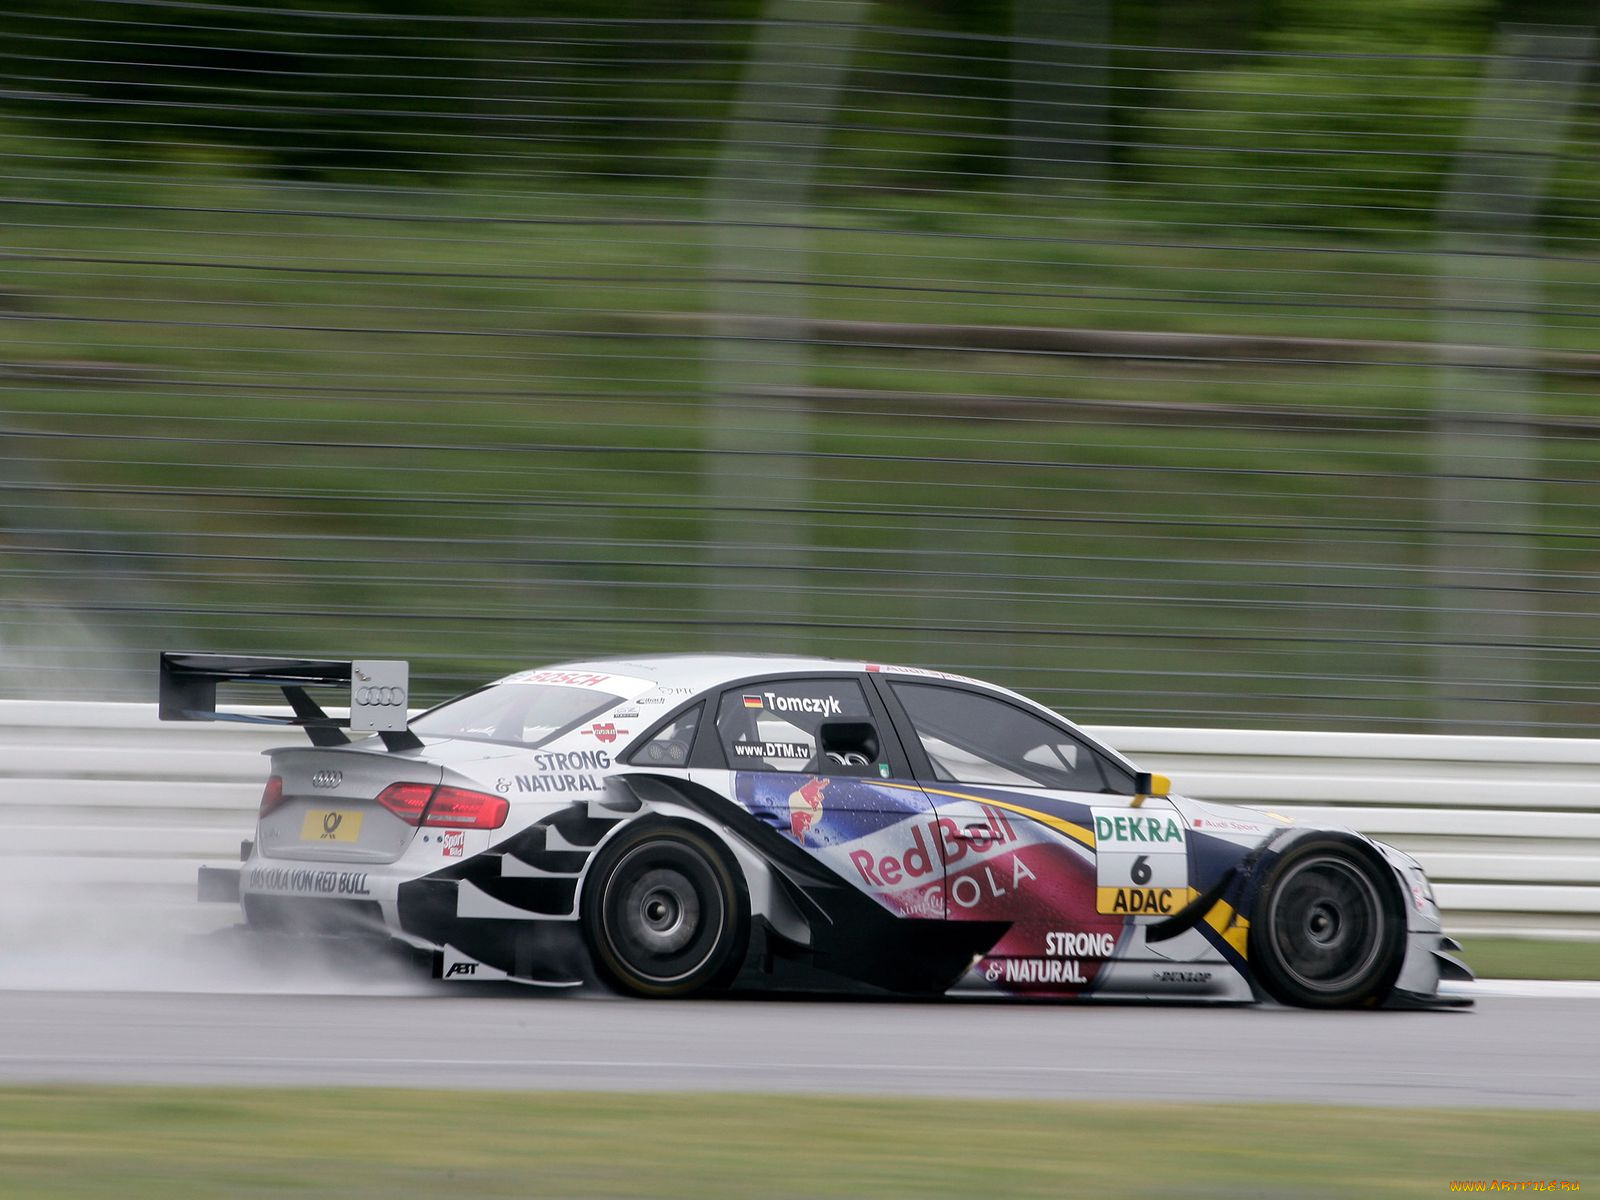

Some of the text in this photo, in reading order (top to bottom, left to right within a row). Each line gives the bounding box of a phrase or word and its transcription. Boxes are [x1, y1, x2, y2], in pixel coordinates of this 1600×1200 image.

[525, 672, 611, 687] BOSCH
[764, 692, 842, 717] Tomczyk
[534, 750, 610, 771] STRONG
[735, 743, 809, 758] www.DTM.tv
[496, 774, 608, 793] & NATURAL.
[1095, 816, 1184, 842] DEKRA
[849, 825, 934, 887] Red
[290, 870, 314, 892] VON
[315, 871, 337, 893] RED
[338, 872, 371, 896] BULL.
[1131, 855, 1152, 886] 6
[924, 854, 1037, 917] COLA
[1113, 889, 1173, 913] ADAC
[1046, 932, 1115, 957] STRONG
[446, 963, 479, 978] ABT
[985, 959, 1088, 984] & NATURAL.
